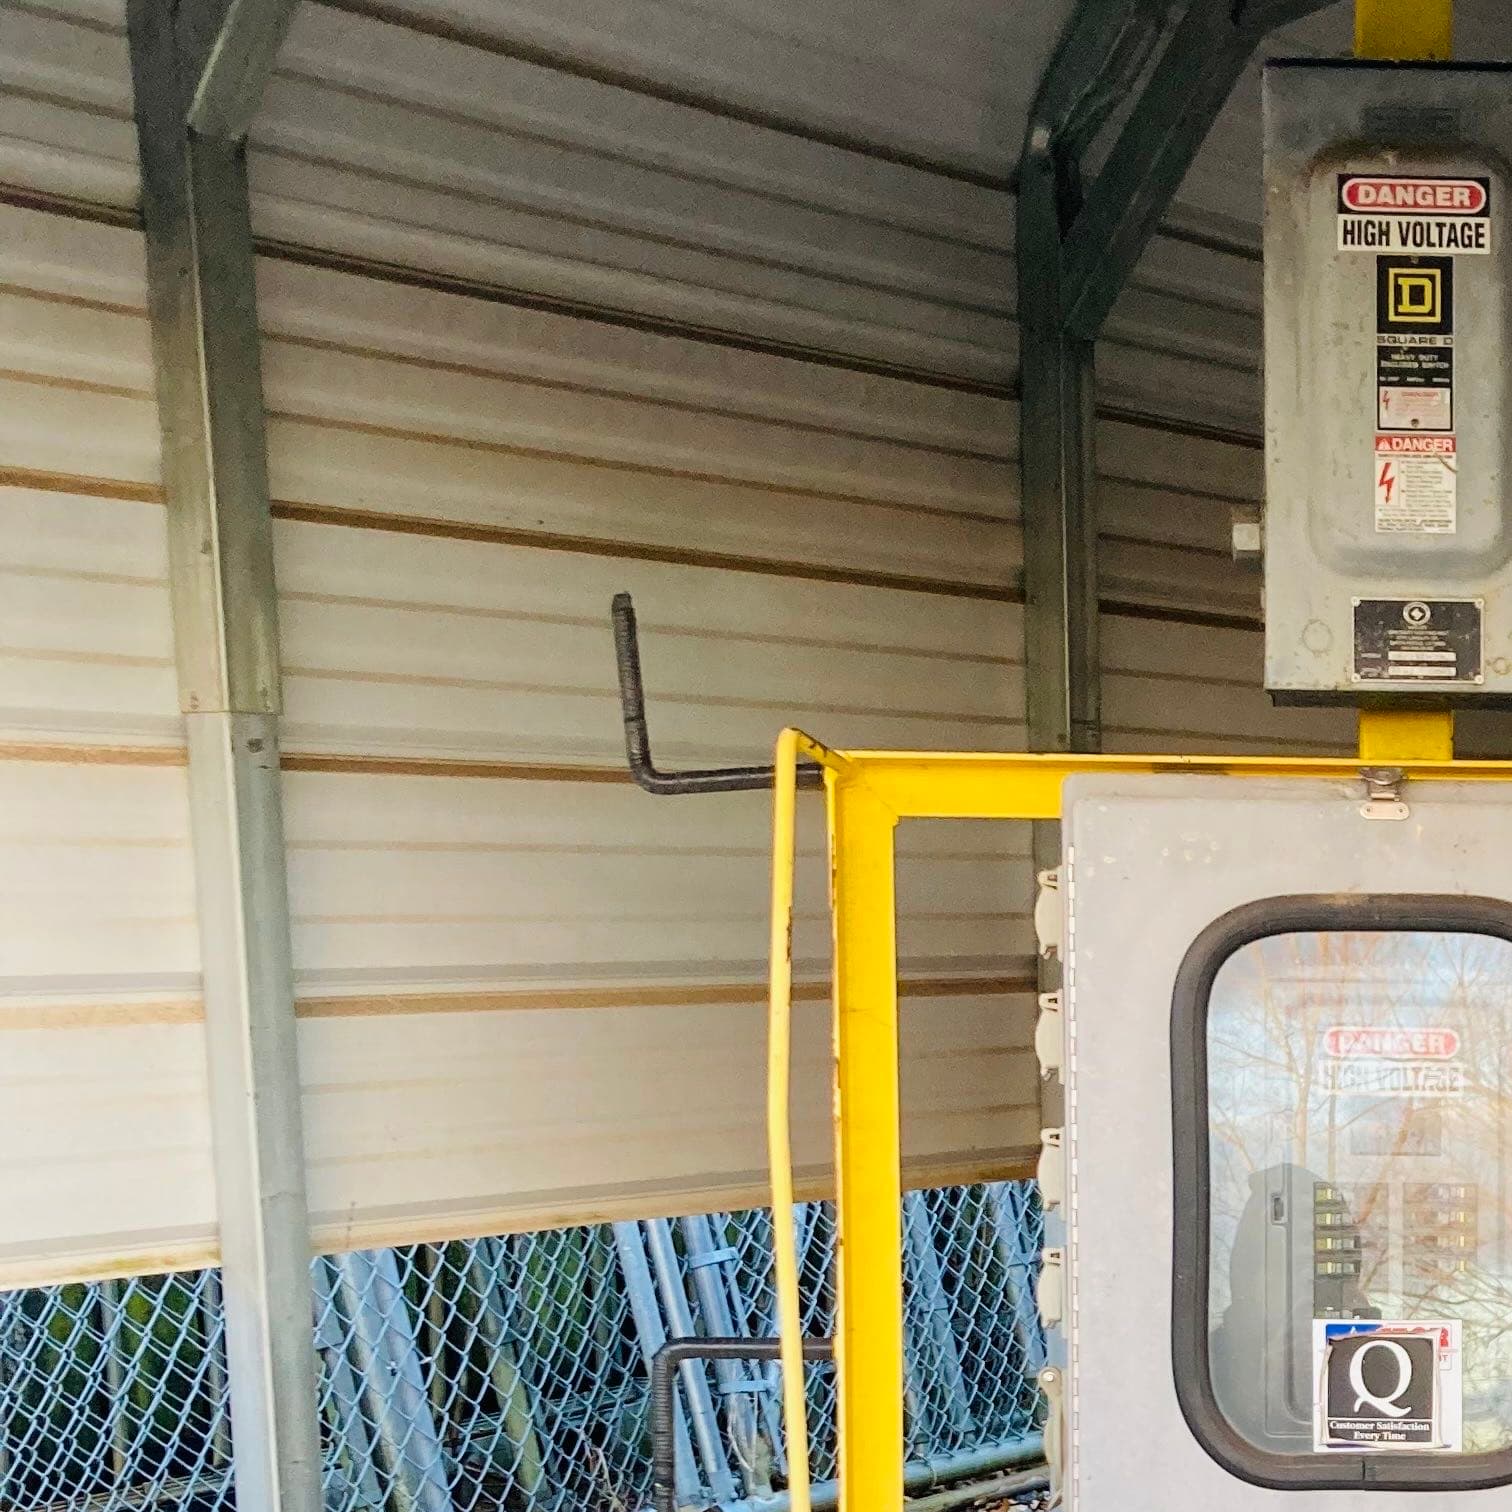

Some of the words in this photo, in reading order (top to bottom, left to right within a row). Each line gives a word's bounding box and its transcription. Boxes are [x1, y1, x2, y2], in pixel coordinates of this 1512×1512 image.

[1358, 185, 1471, 207] DANGER
[1342, 219, 1391, 246] HIGH
[1398, 220, 1485, 249] VOLTAGE
[1377, 335, 1437, 345] SQUARE
[1443, 336, 1454, 345] D
[1392, 437, 1453, 452] DANGER
[1338, 1032, 1446, 1054] DANGER
[1350, 1340, 1412, 1417] Q
[1329, 1421, 1375, 1431] Customer
[1376, 1421, 1430, 1431] Satisfaction
[1353, 1431, 1381, 1442] Every
[1383, 1432, 1407, 1441] Time
